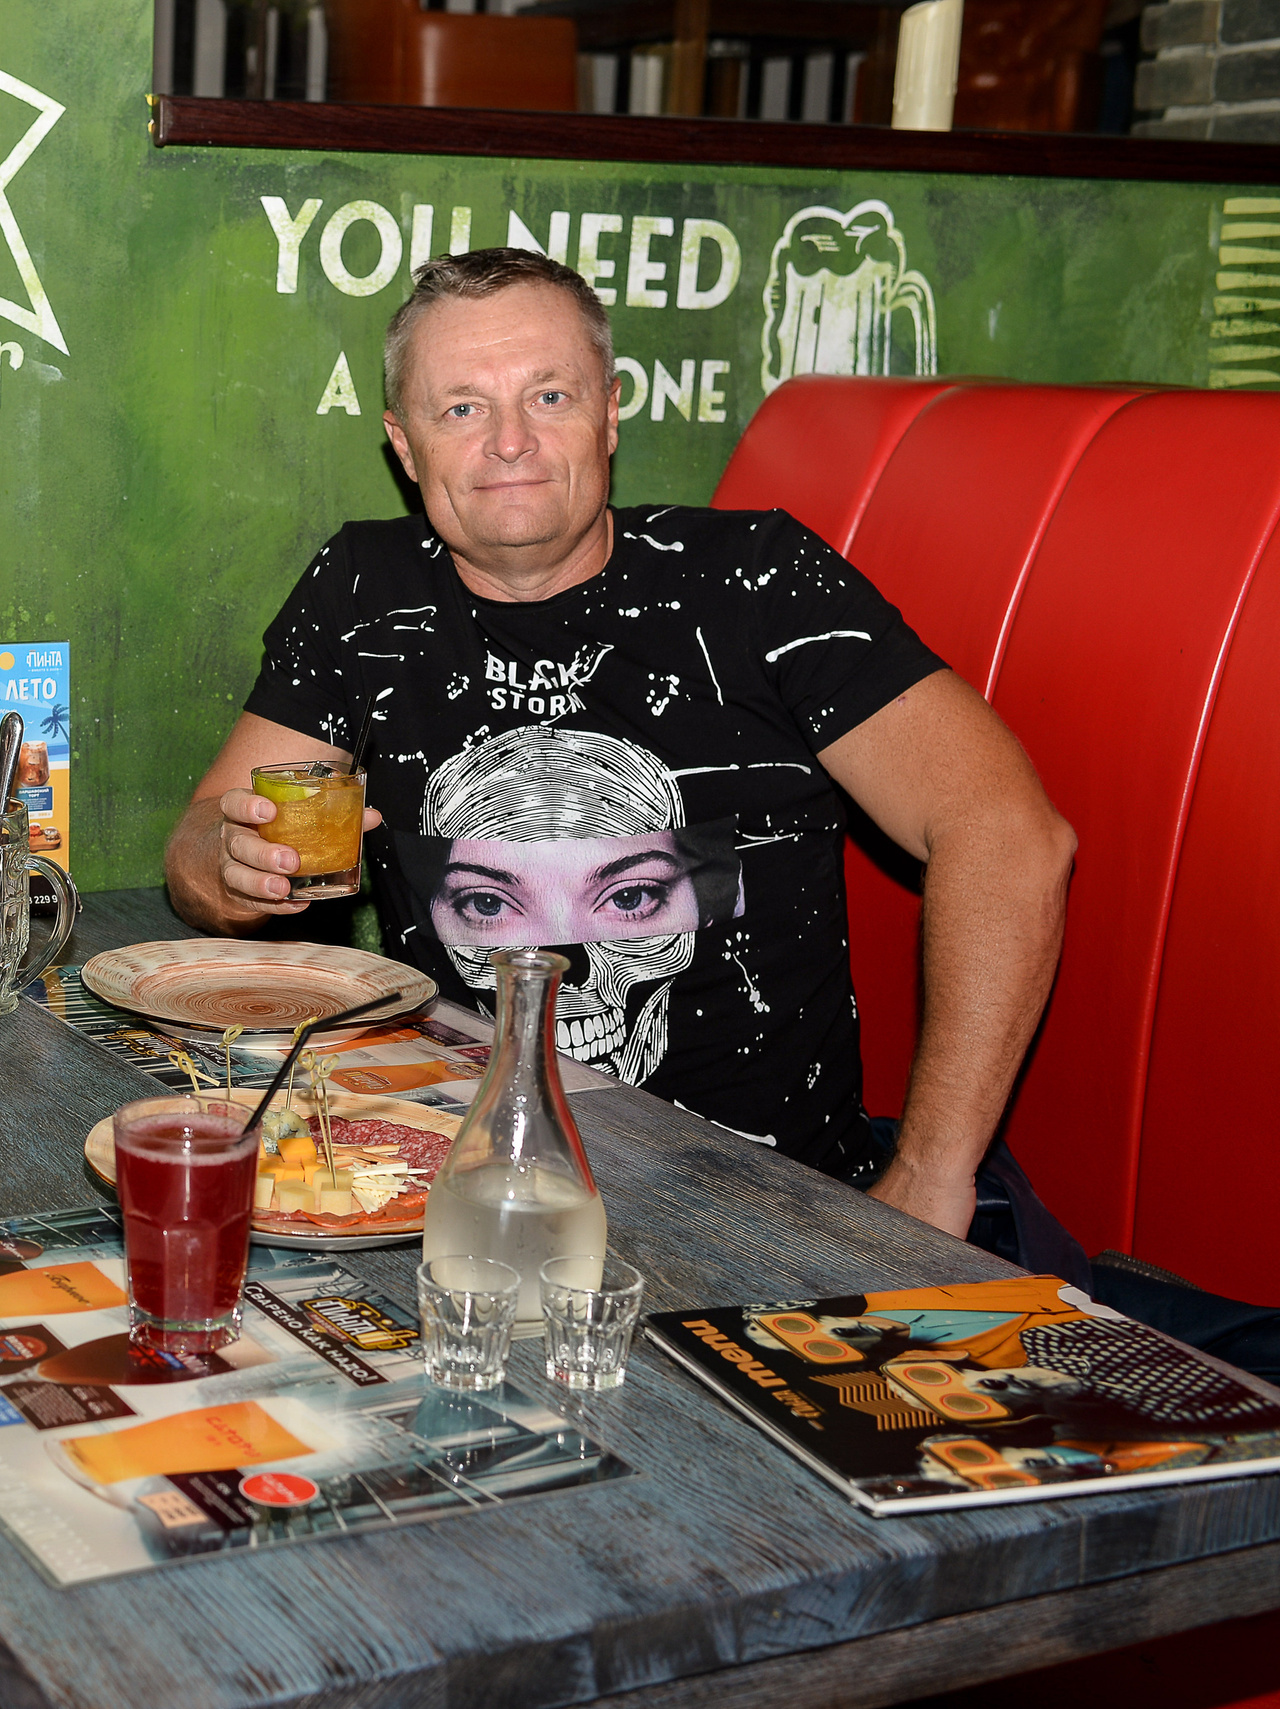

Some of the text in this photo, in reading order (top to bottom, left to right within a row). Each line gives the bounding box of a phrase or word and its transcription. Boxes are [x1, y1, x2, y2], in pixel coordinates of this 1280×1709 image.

[316, 351, 362, 417] A
[5, 677, 57, 701] ЛЕТО
[681, 1319, 788, 1388] menu
